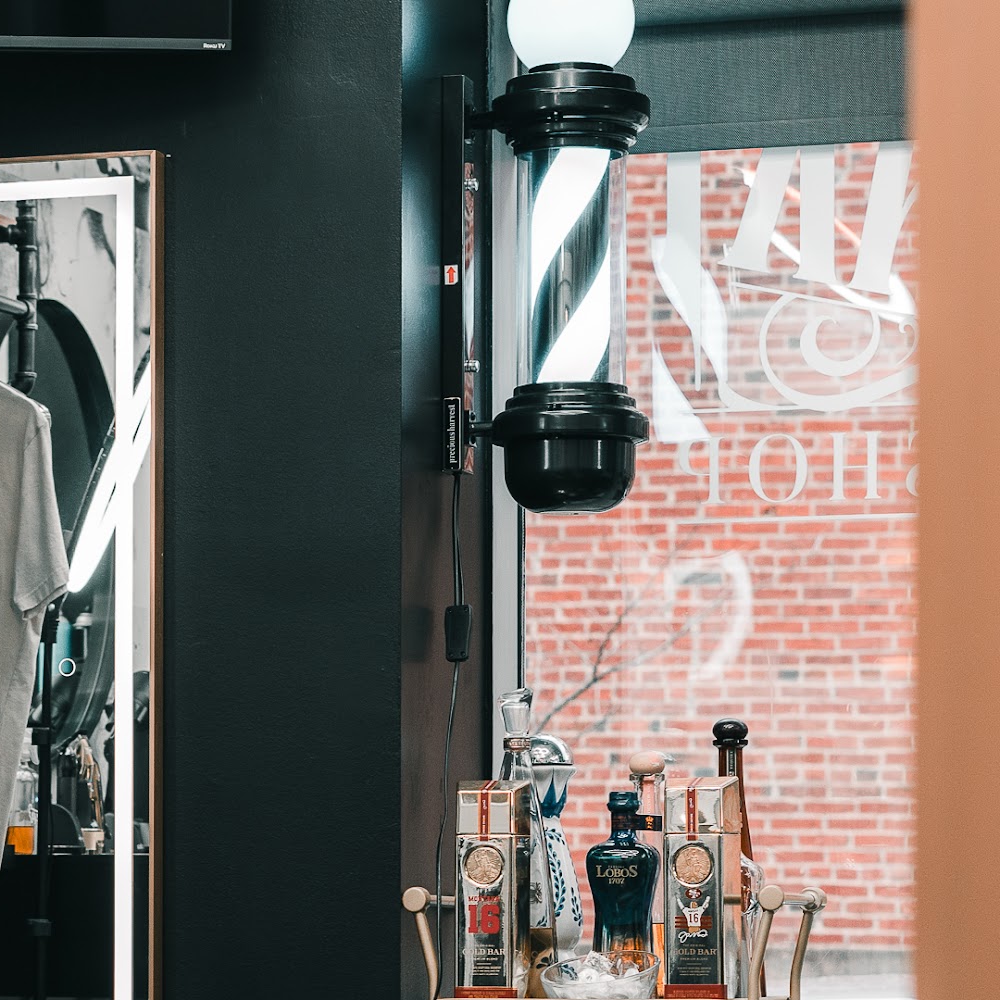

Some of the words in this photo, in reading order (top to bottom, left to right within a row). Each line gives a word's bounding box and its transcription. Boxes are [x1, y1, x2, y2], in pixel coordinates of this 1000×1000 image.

[446, 404, 456, 431] harvest
[446, 432, 458, 464] precious
[596, 865, 638, 878] LOBOS
[468, 904, 500, 934] 16
[689, 913, 699, 923] 16
[462, 948, 485, 956] GOLD
[487, 948, 506, 956] BAR
[673, 948, 696, 956] GOLD
[697, 948, 718, 956] BAR
